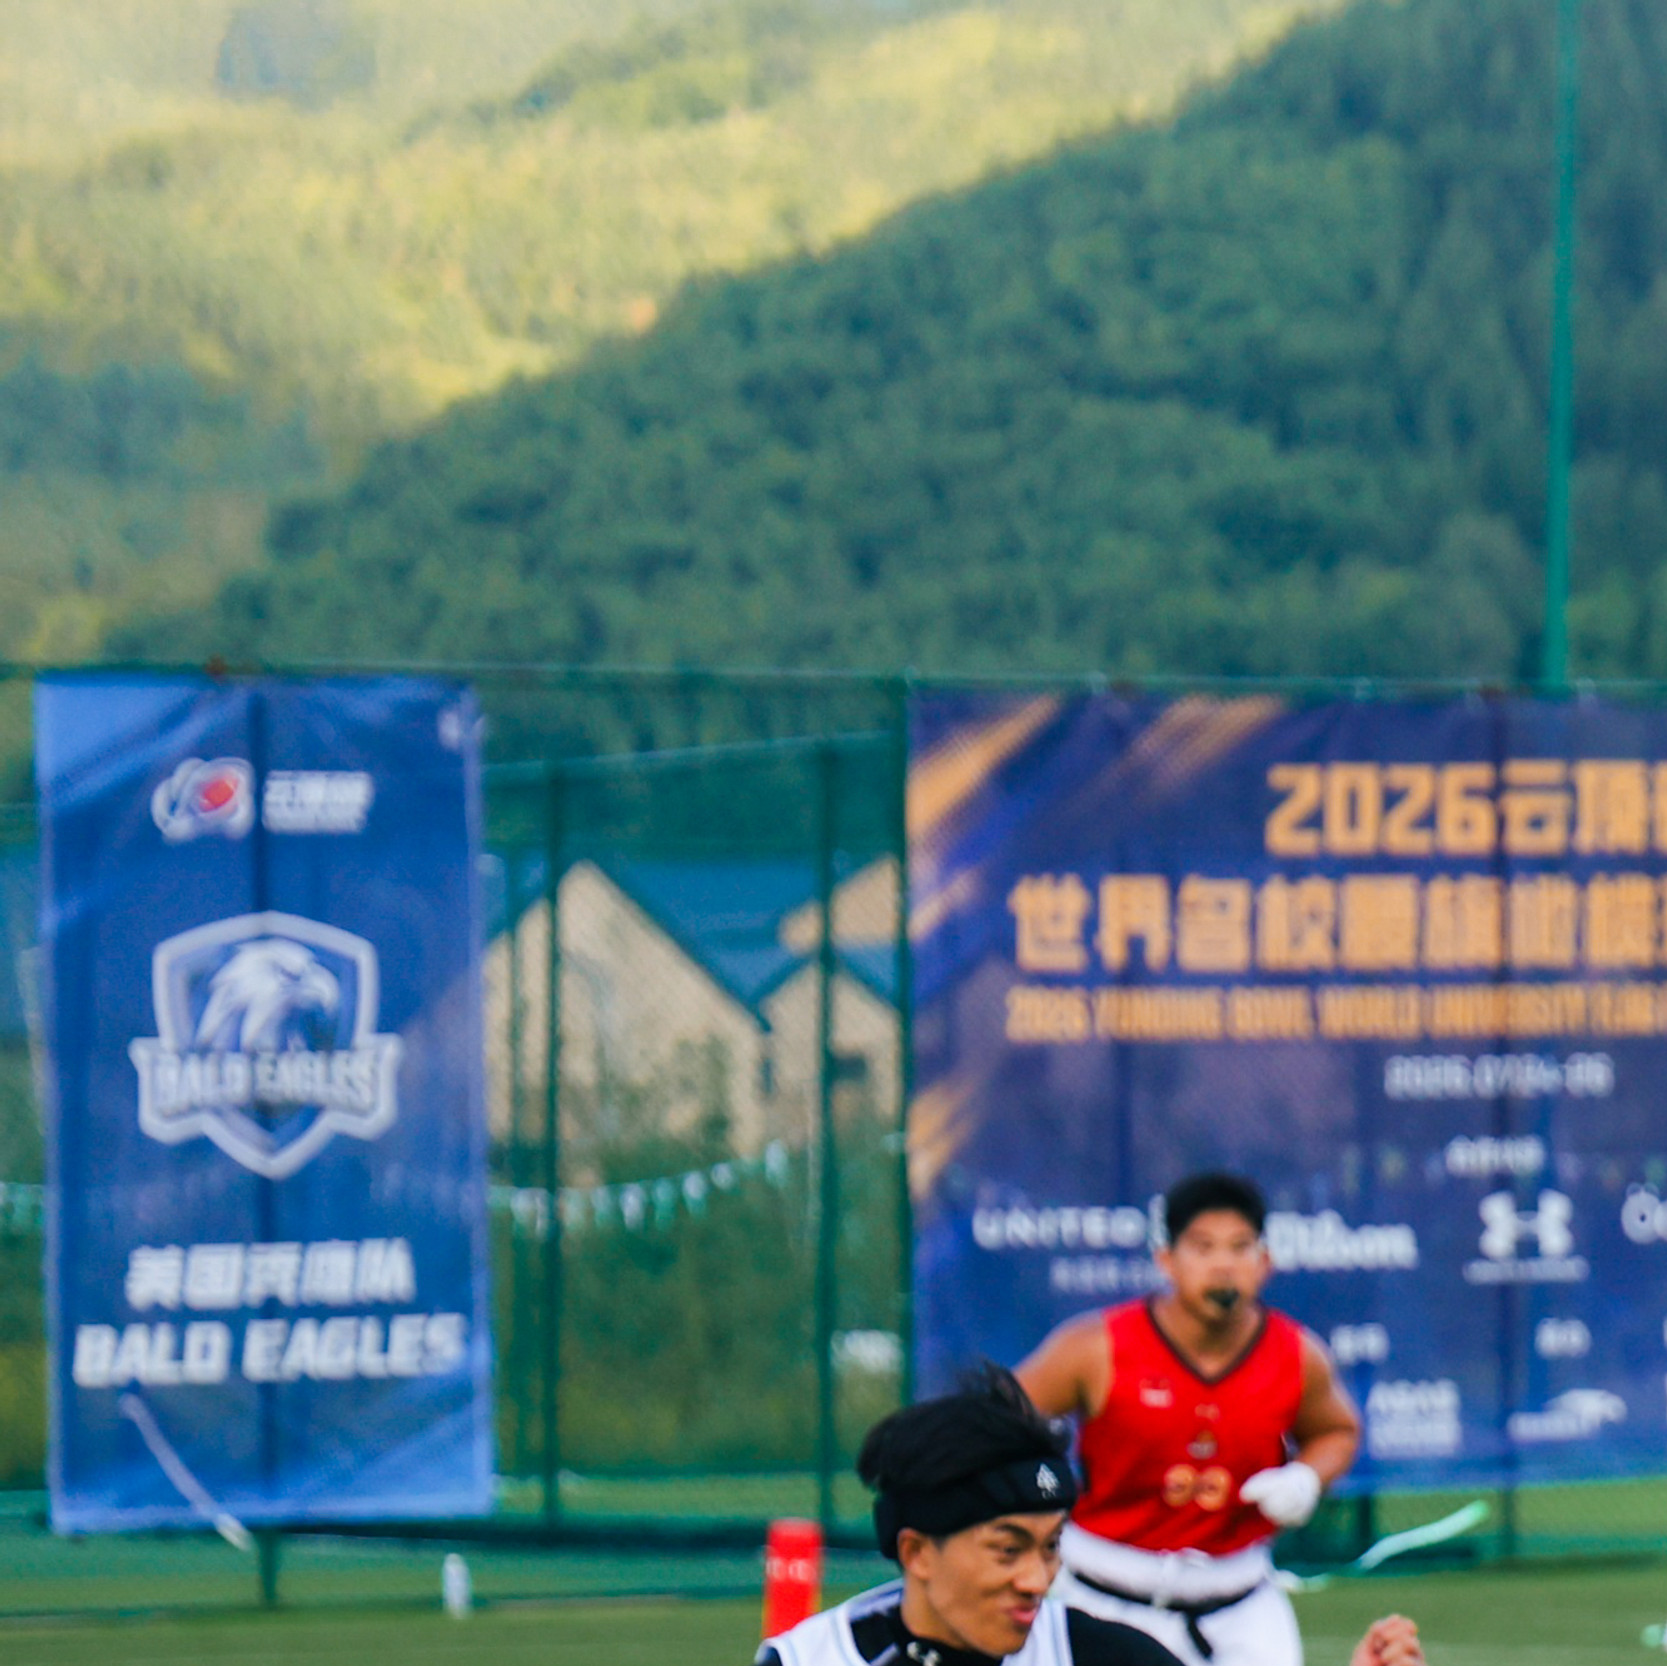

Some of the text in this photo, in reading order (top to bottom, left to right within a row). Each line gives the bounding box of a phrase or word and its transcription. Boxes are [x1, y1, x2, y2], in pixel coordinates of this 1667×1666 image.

[973, 1206, 1149, 1249] UNITED
[73, 1312, 470, 1388] BALD EAGLES
